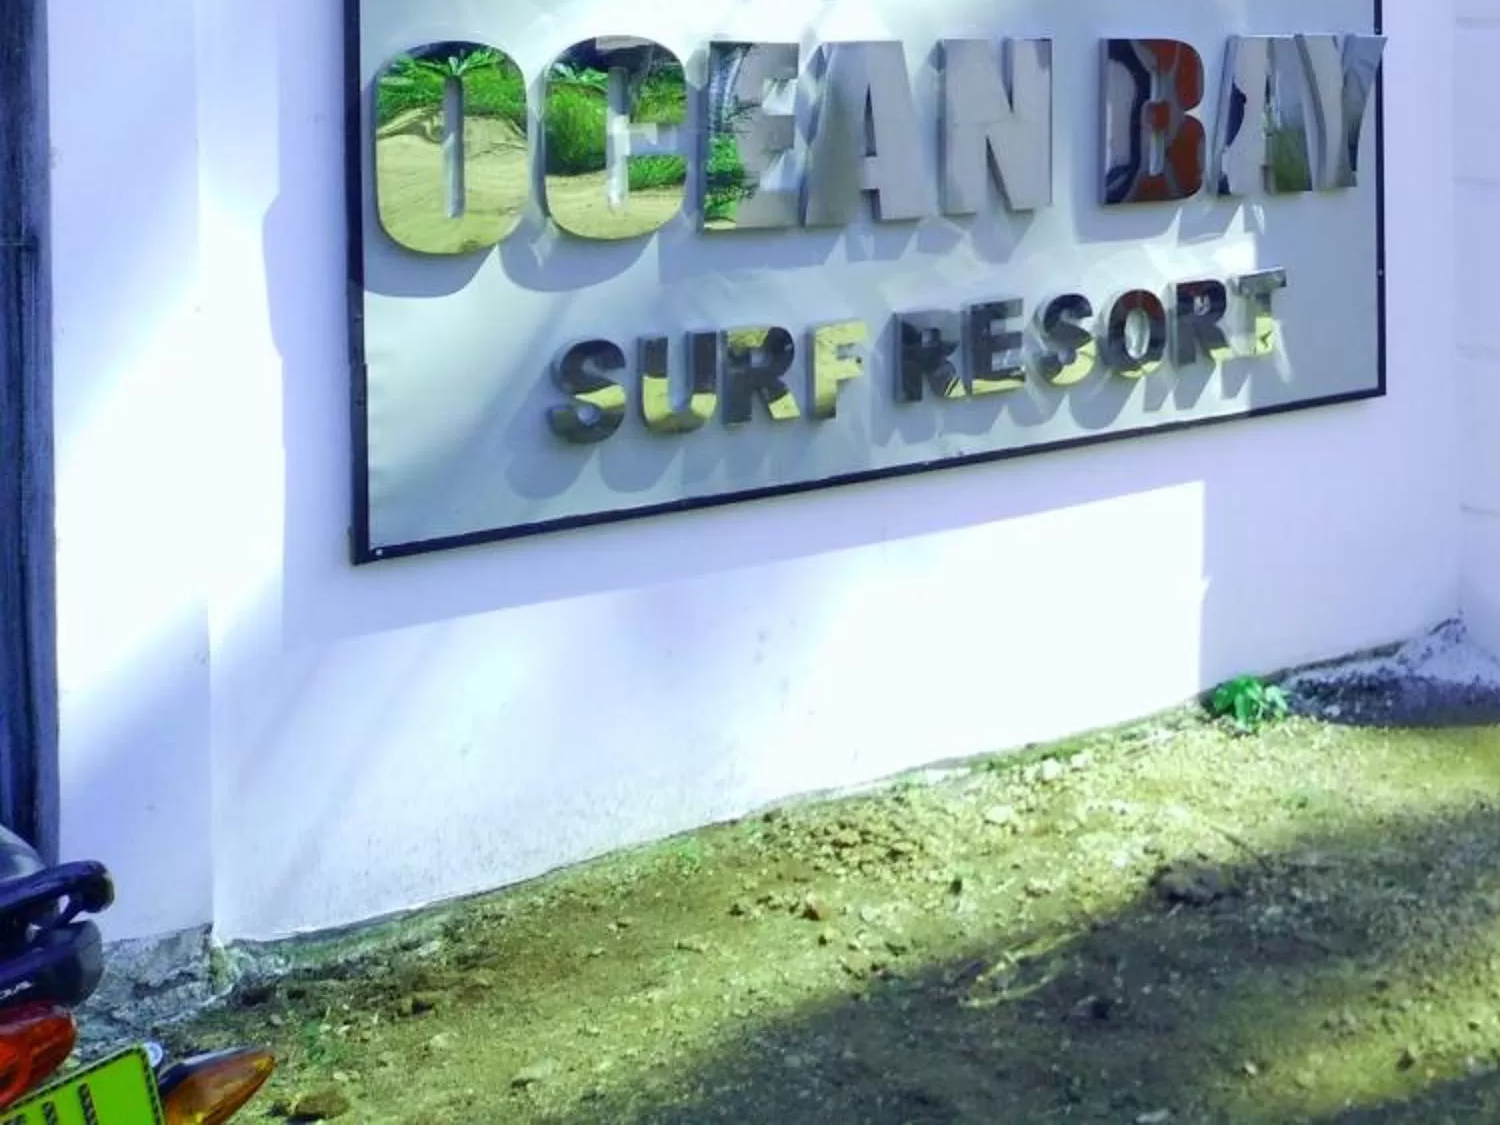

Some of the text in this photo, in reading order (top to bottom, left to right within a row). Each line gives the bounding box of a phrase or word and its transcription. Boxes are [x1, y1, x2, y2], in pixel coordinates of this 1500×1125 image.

[373, 35, 1388, 255] OCEAN BAY
[551, 268, 1287, 444] SURF RESORT
